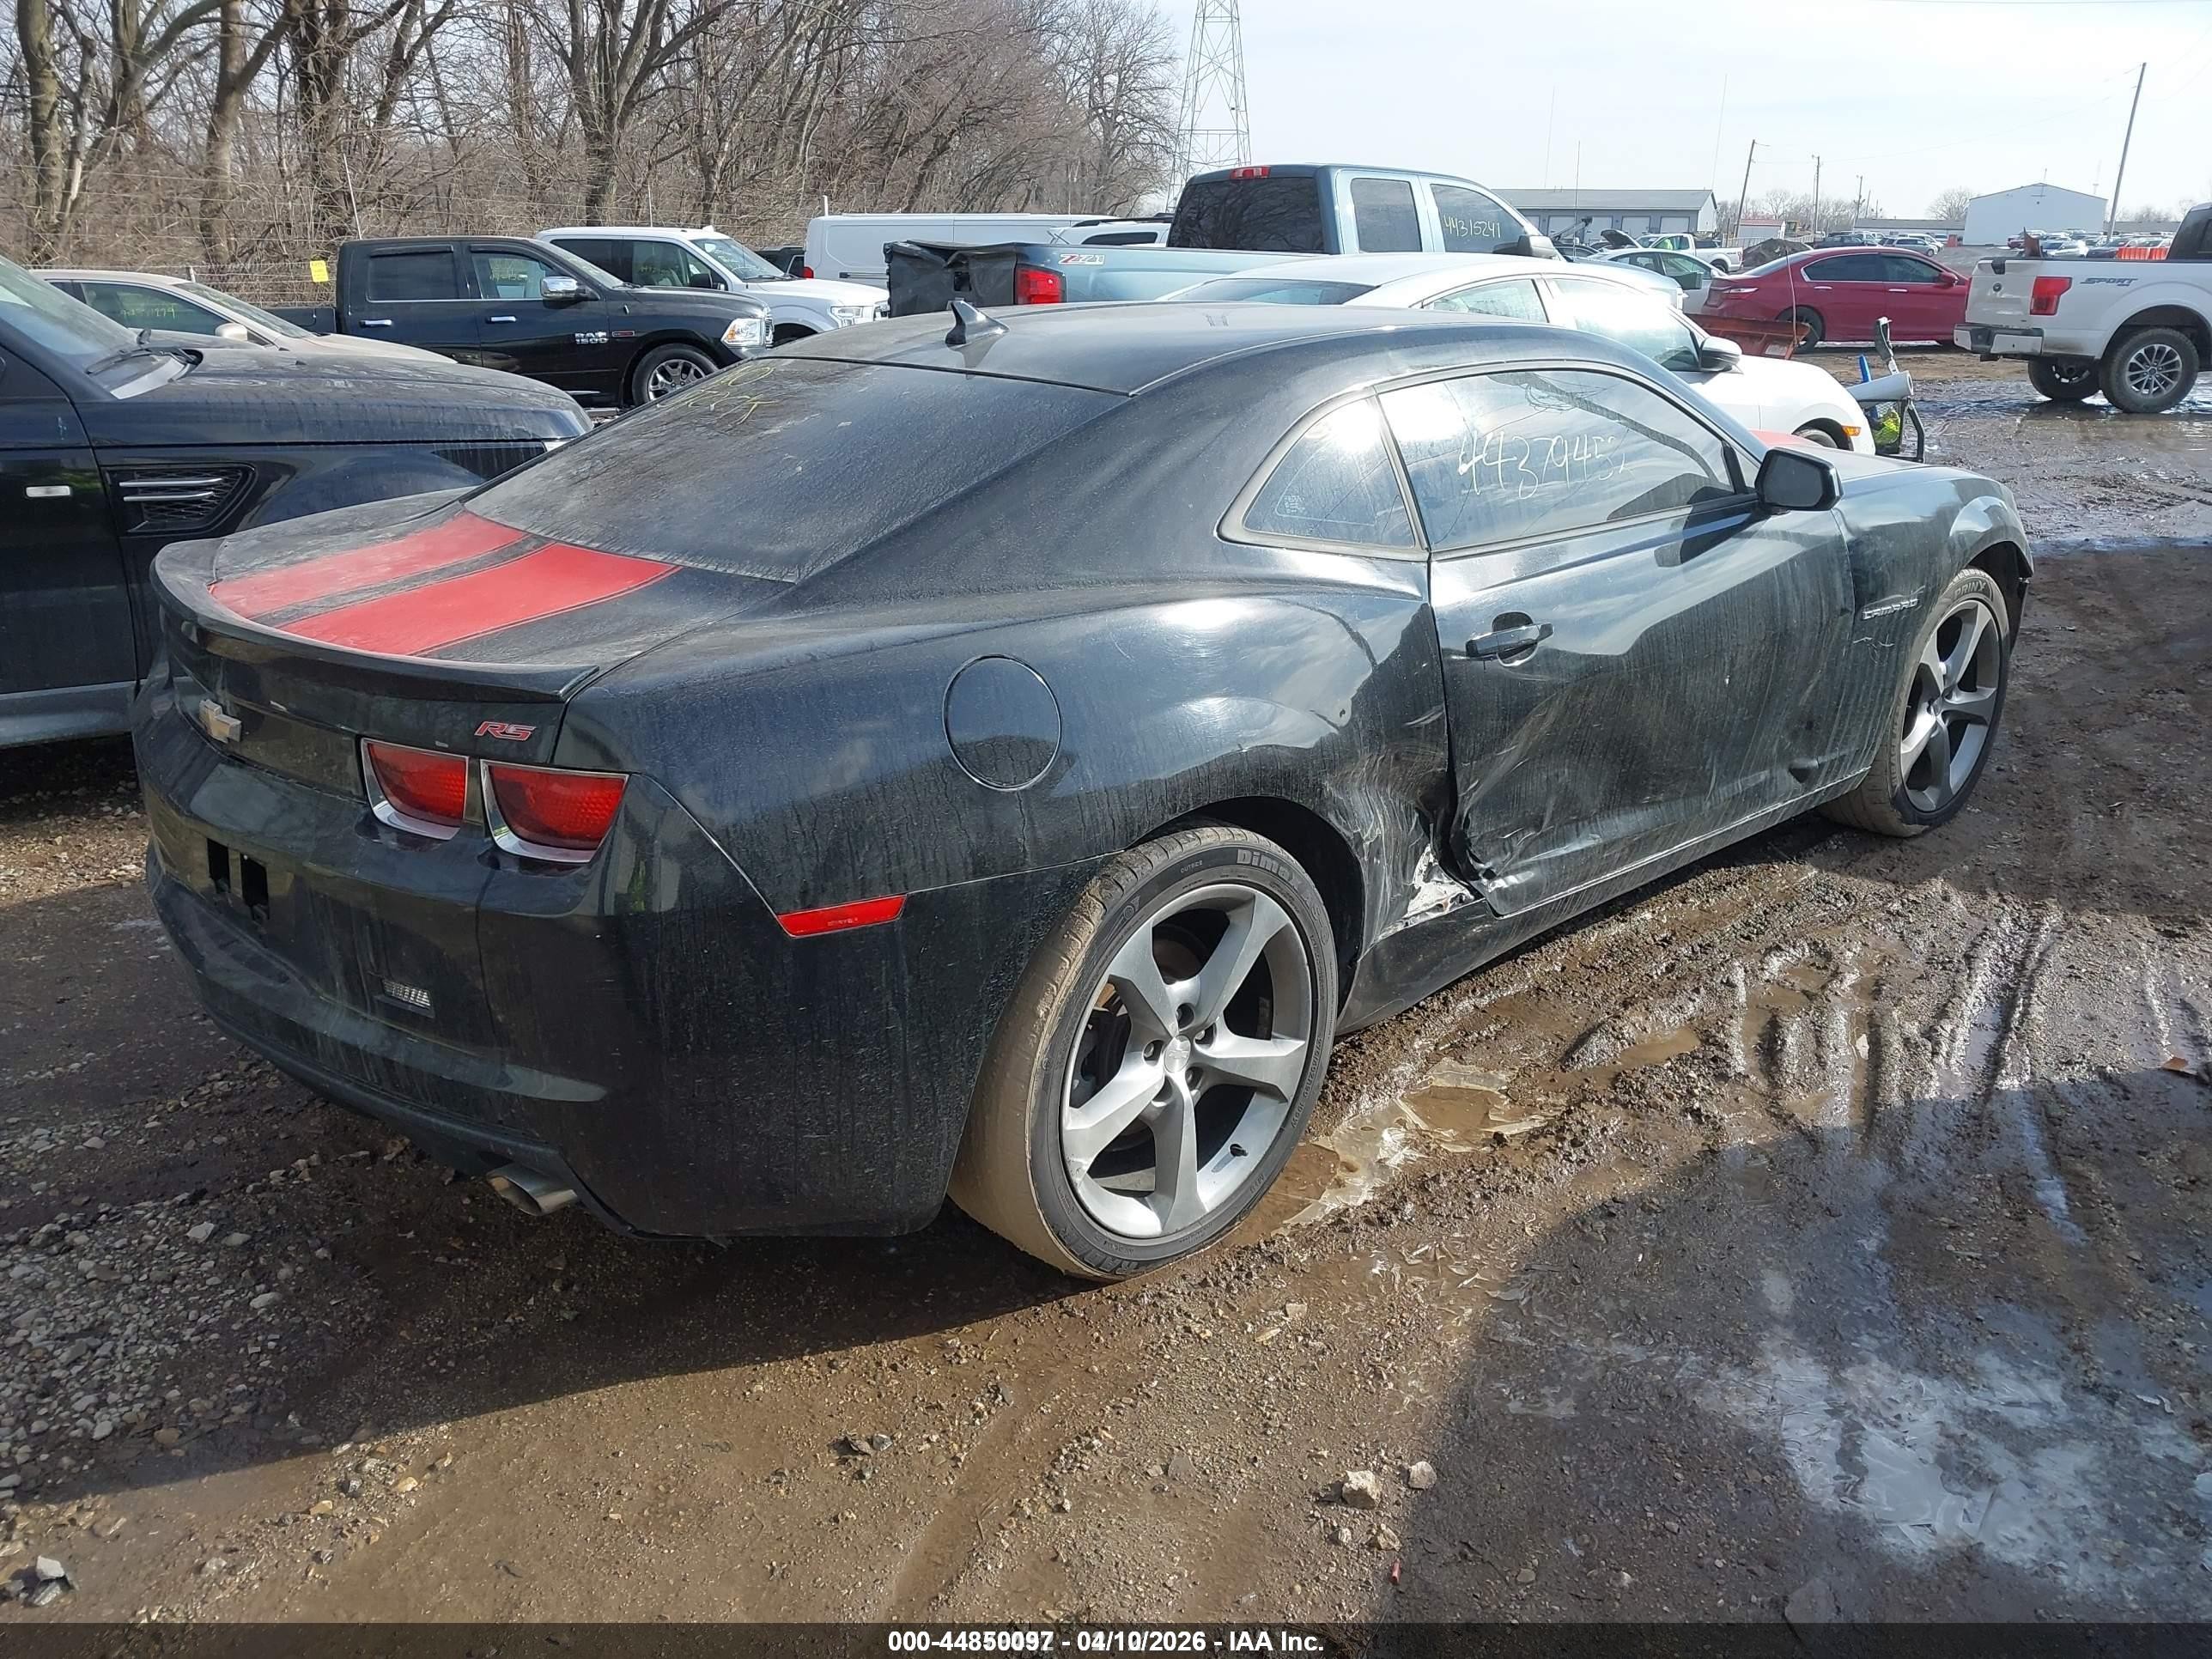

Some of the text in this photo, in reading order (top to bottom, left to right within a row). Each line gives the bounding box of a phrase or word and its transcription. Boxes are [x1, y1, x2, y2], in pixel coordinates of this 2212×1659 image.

[1443, 214, 1501, 239] 44315241
[1058, 253, 1105, 265] Z71
[2080, 277, 2139, 286] SPORT
[1954, 580, 1987, 600] PRINX
[1862, 599, 1919, 620] CAMARO
[474, 720, 537, 741] RS
[1237, 848, 1304, 891] Dimax
